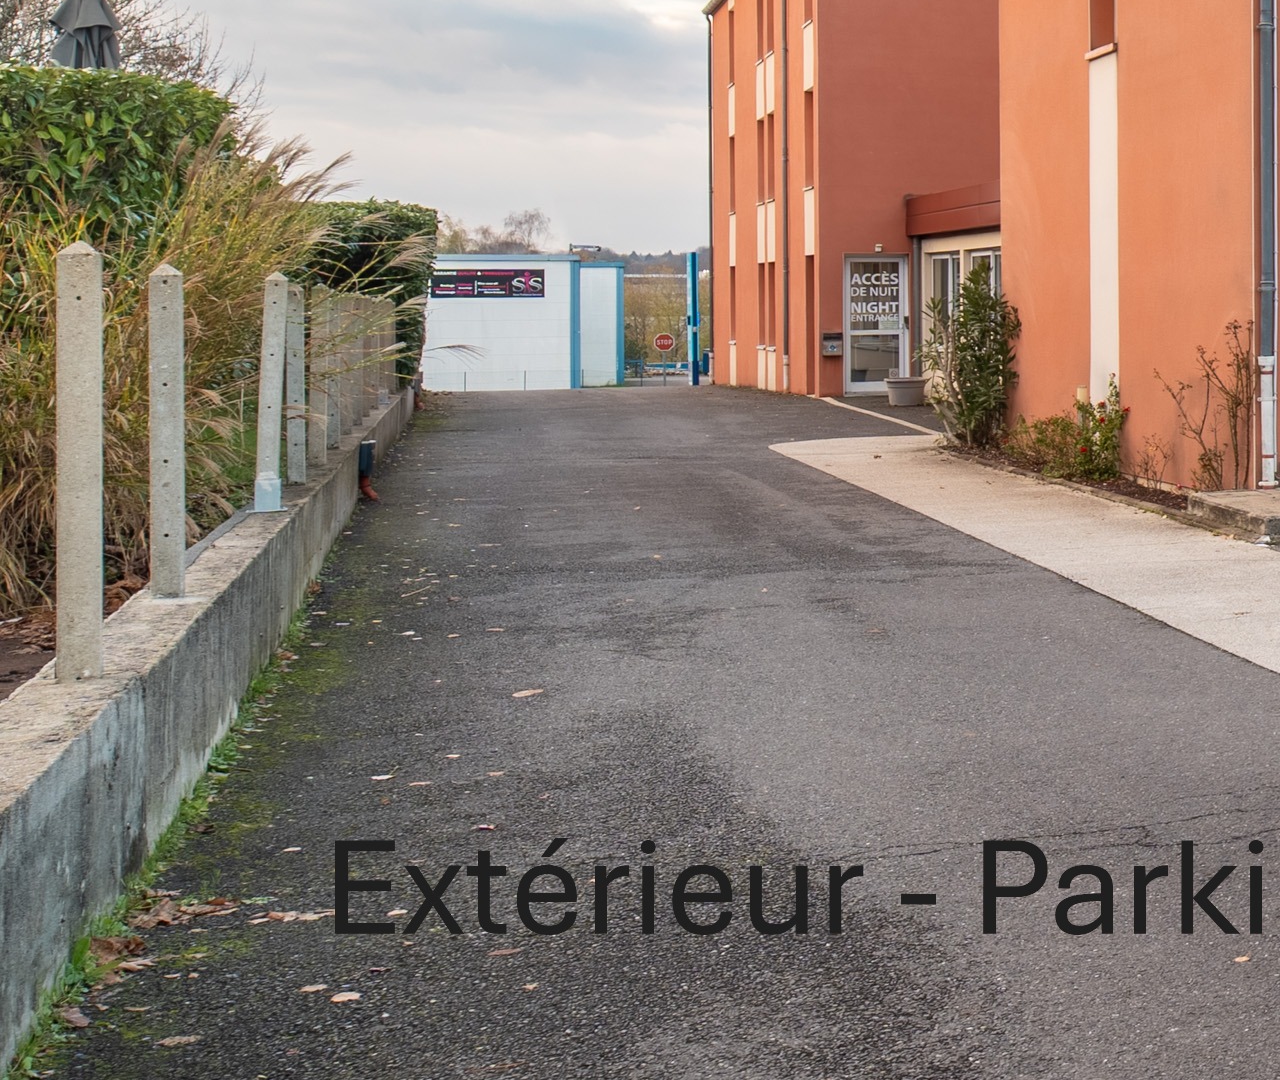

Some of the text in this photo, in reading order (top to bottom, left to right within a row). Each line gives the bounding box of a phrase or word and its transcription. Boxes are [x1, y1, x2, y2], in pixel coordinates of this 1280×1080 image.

[851, 271, 899, 285] ACCÈS
[851, 286, 899, 297] DE NUIT
[851, 302, 899, 314] NIGHT
[851, 313, 899, 322] ENTRANCE
